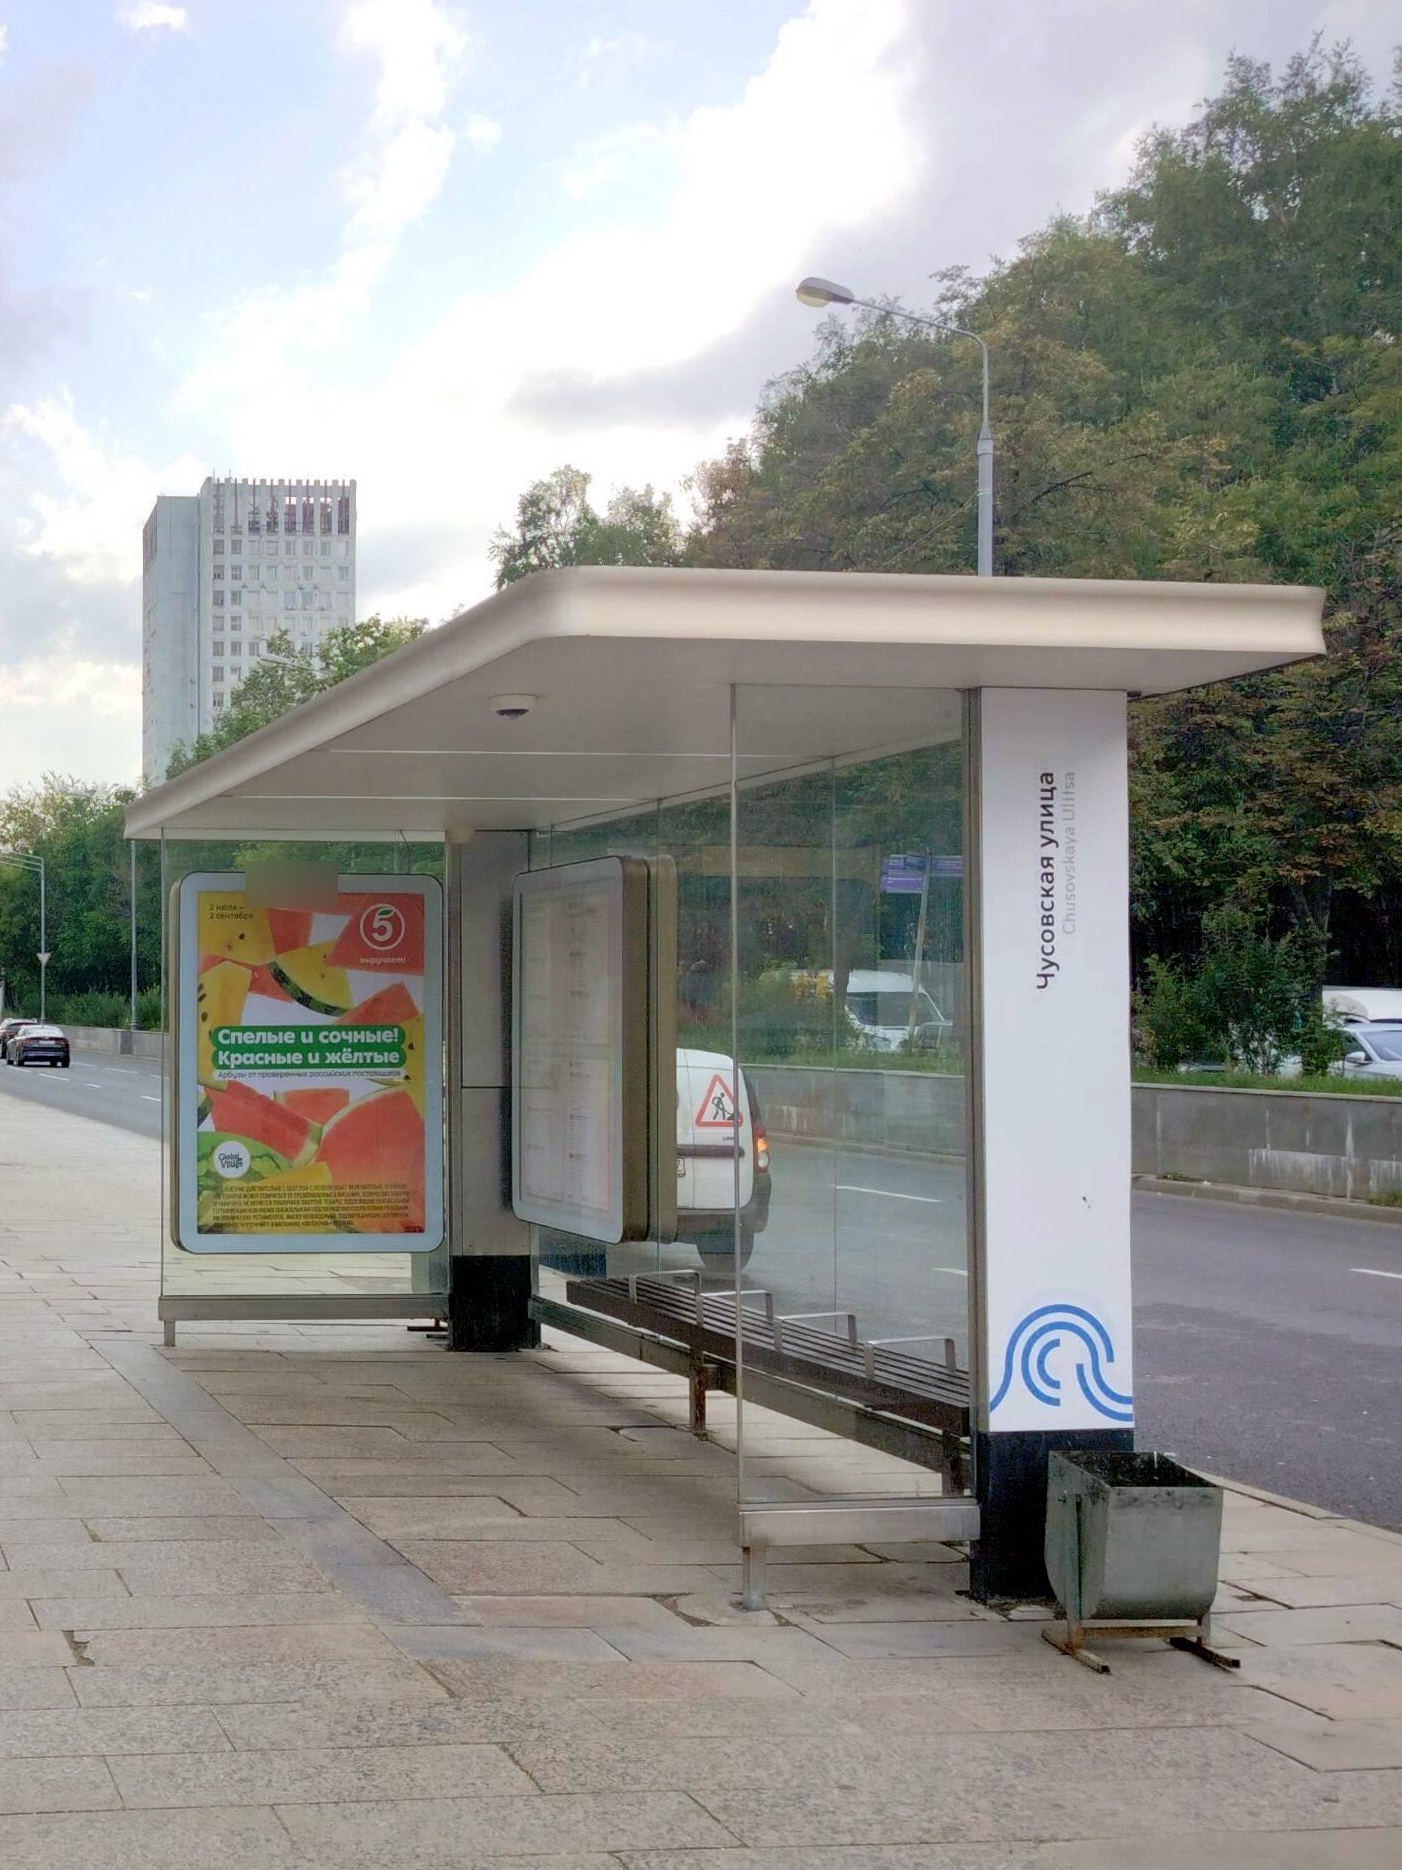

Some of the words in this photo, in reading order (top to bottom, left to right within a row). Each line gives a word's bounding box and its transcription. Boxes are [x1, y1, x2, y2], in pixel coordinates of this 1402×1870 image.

[1039, 772, 1059, 848] улица
[1062, 771, 1075, 821] Ulitsa
[1061, 826, 1077, 935] Chusovskaya
[1036, 856, 1059, 989] Чусовская
[218, 1028, 296, 1045] Спелые
[300, 1031, 313, 1044] и
[318, 1027, 398, 1044] сочные!
[218, 1050, 303, 1069] Красные
[307, 1051, 320, 1064] и
[325, 1047, 400, 1064] жёлтые
